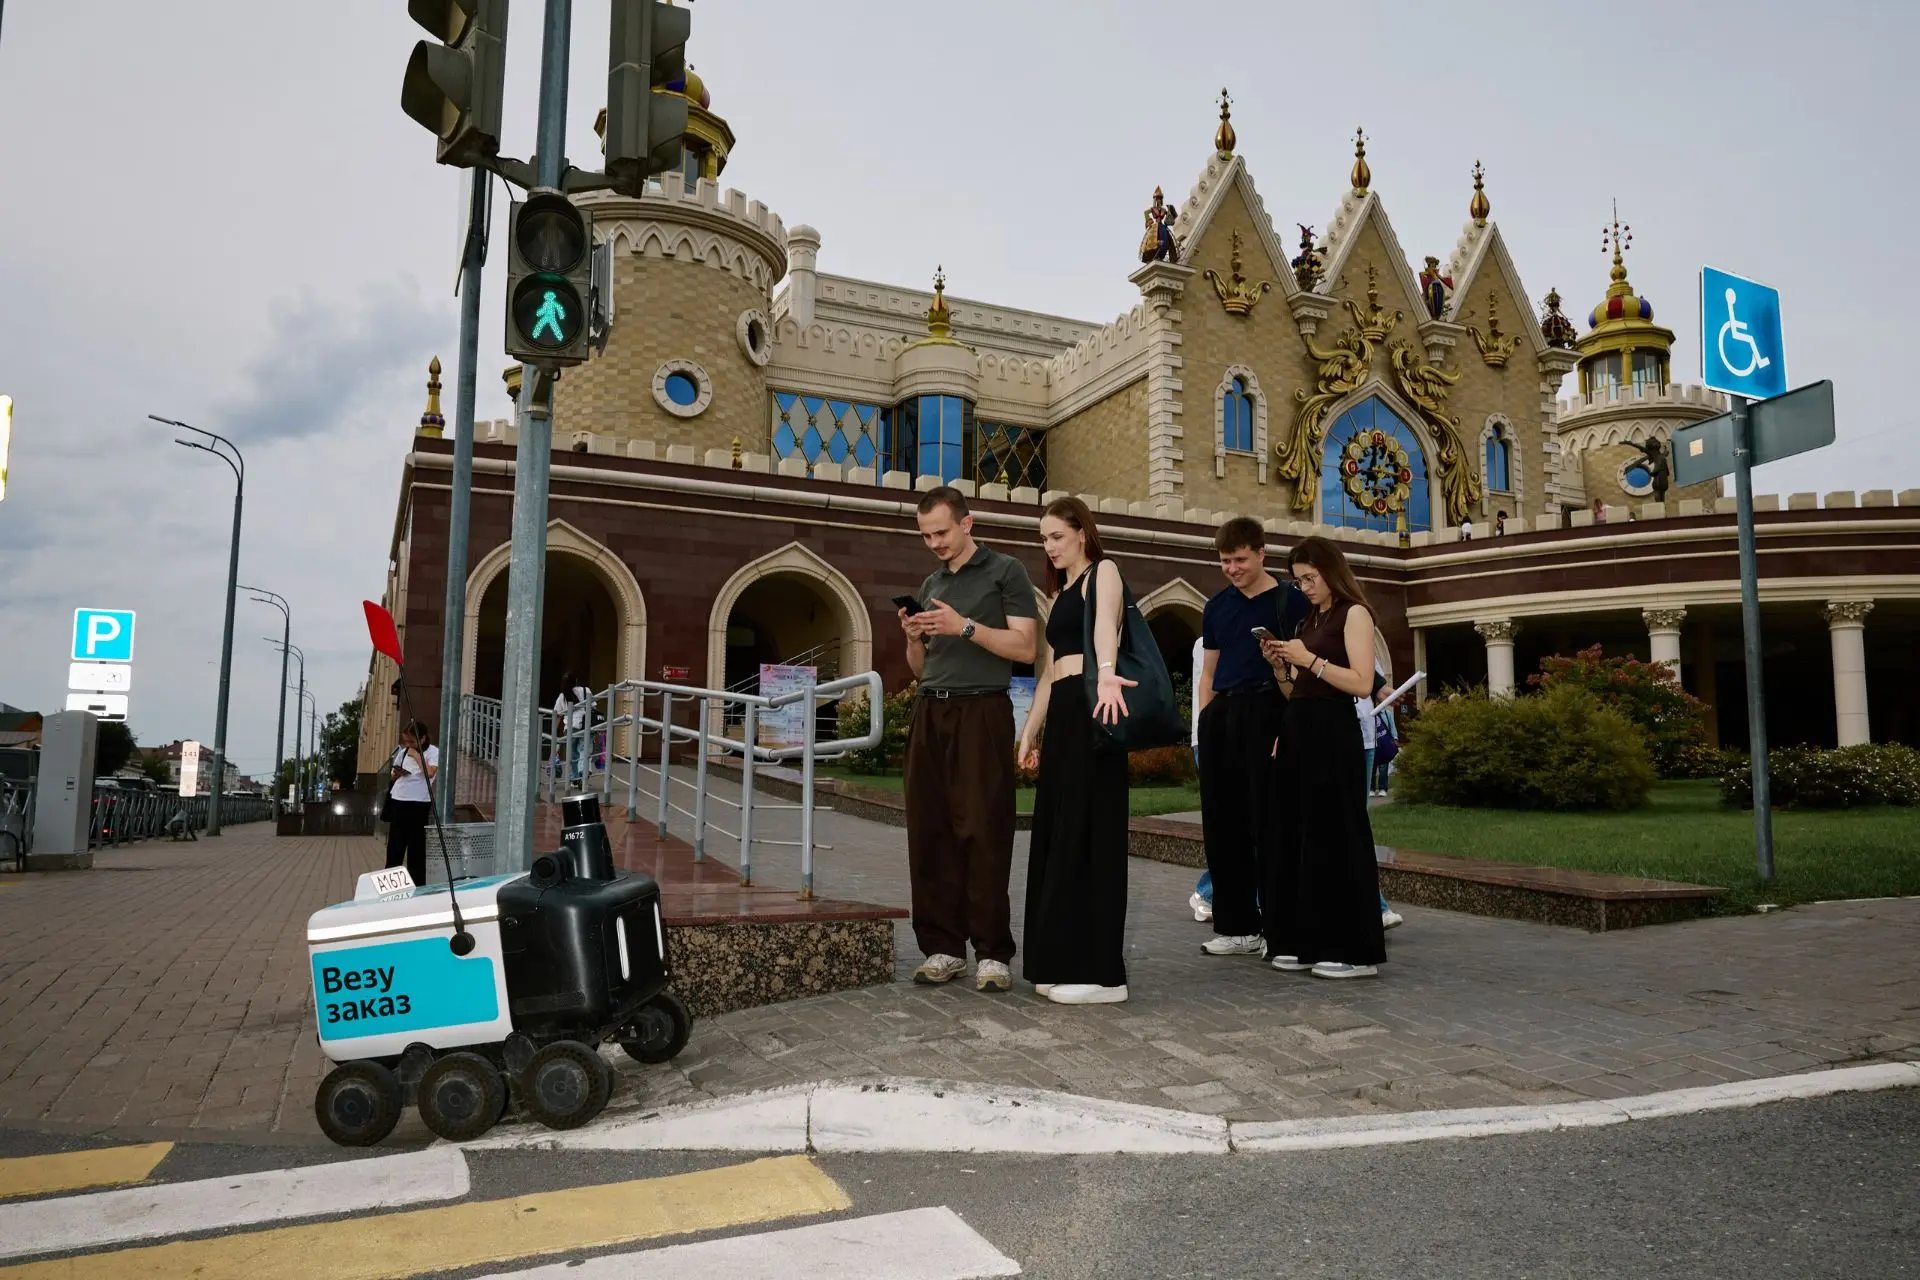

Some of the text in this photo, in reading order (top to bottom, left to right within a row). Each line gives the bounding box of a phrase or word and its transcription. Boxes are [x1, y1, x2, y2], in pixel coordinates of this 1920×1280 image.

[86, 615, 121, 655] P
[564, 831, 585, 840] A1672
[376, 870, 410, 891] A1672
[322, 965, 395, 994] Везу
[326, 994, 411, 1024] заказ
